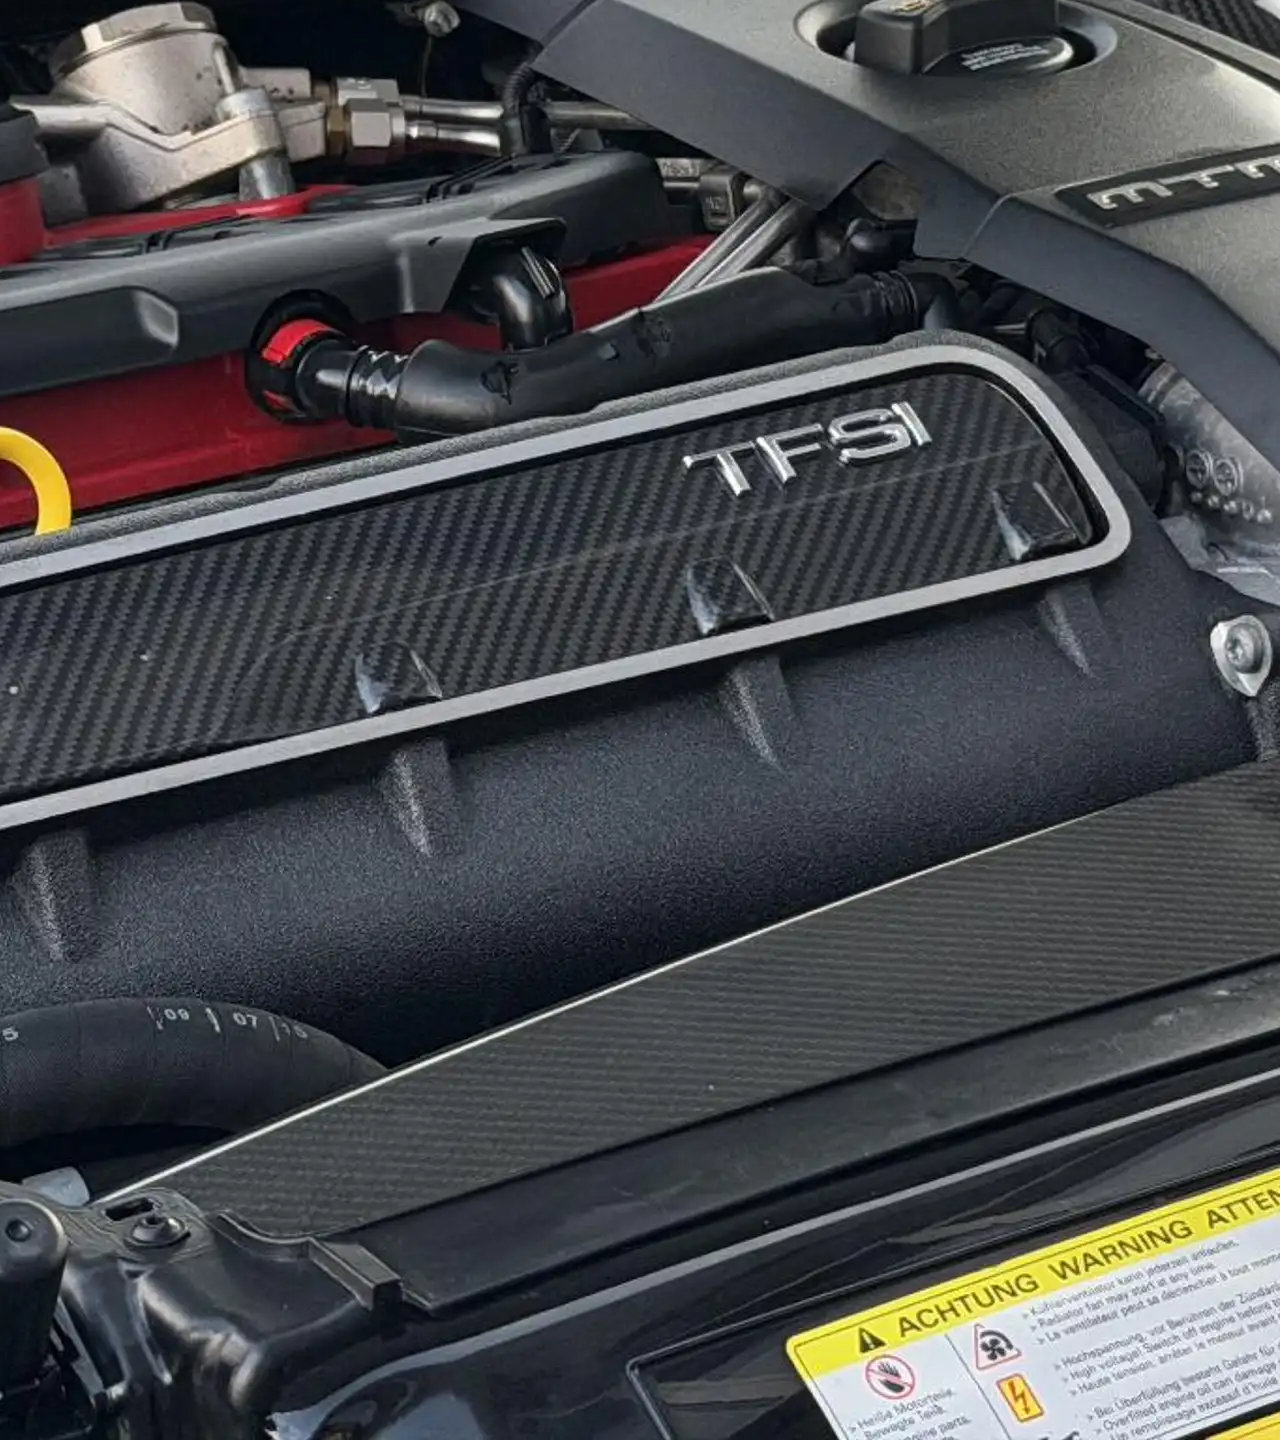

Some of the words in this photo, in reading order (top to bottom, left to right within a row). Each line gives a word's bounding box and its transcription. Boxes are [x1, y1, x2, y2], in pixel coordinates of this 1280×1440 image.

[682, 400, 932, 497] TFSI
[232, 1011, 259, 1029] 07
[897, 1274, 1040, 1338] ACHTUNG
[1047, 1220, 1194, 1281] WARNING
